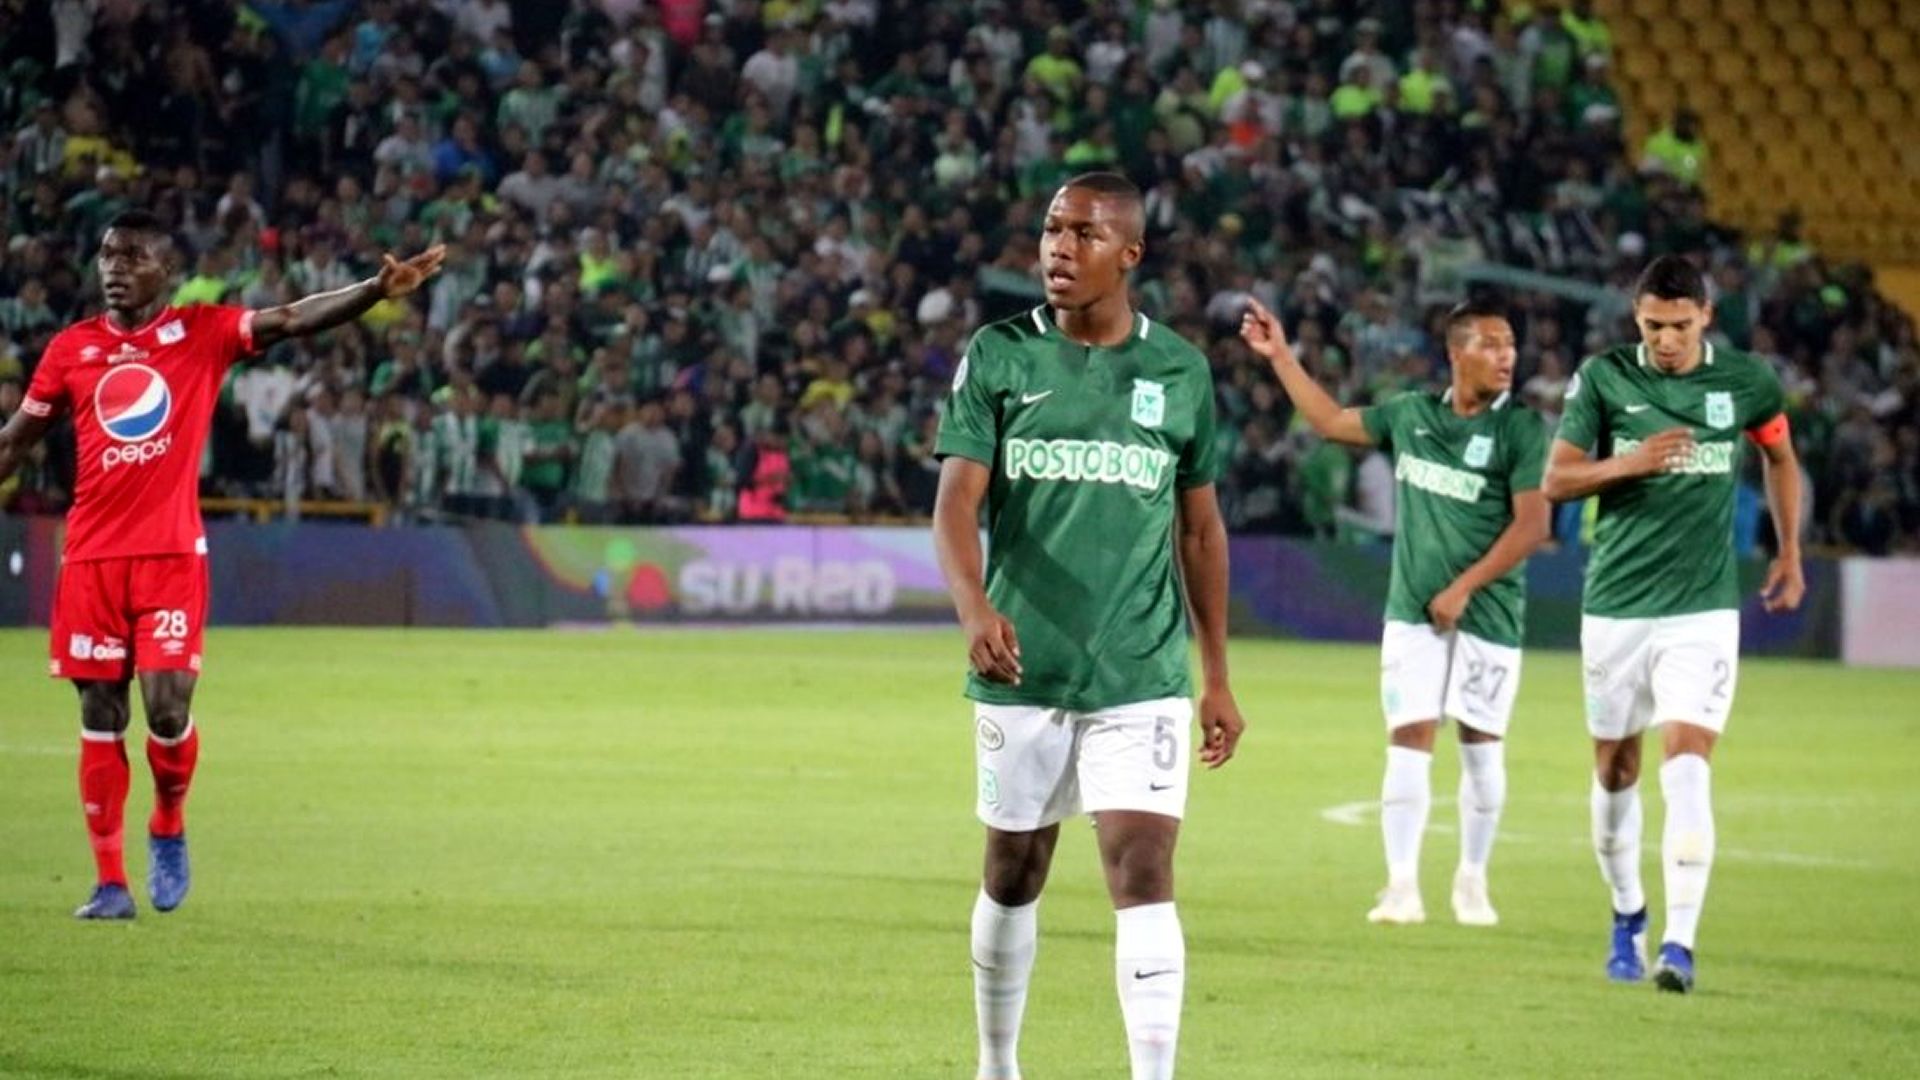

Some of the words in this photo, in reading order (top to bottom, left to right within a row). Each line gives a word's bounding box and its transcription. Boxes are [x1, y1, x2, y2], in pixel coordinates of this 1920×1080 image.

[1006, 438, 1169, 490] POSTOBON
[153, 609, 188, 639] 28
[1461, 660, 1508, 702] 27
[1712, 659, 1730, 699] 2
[1153, 715, 1178, 771] 5
